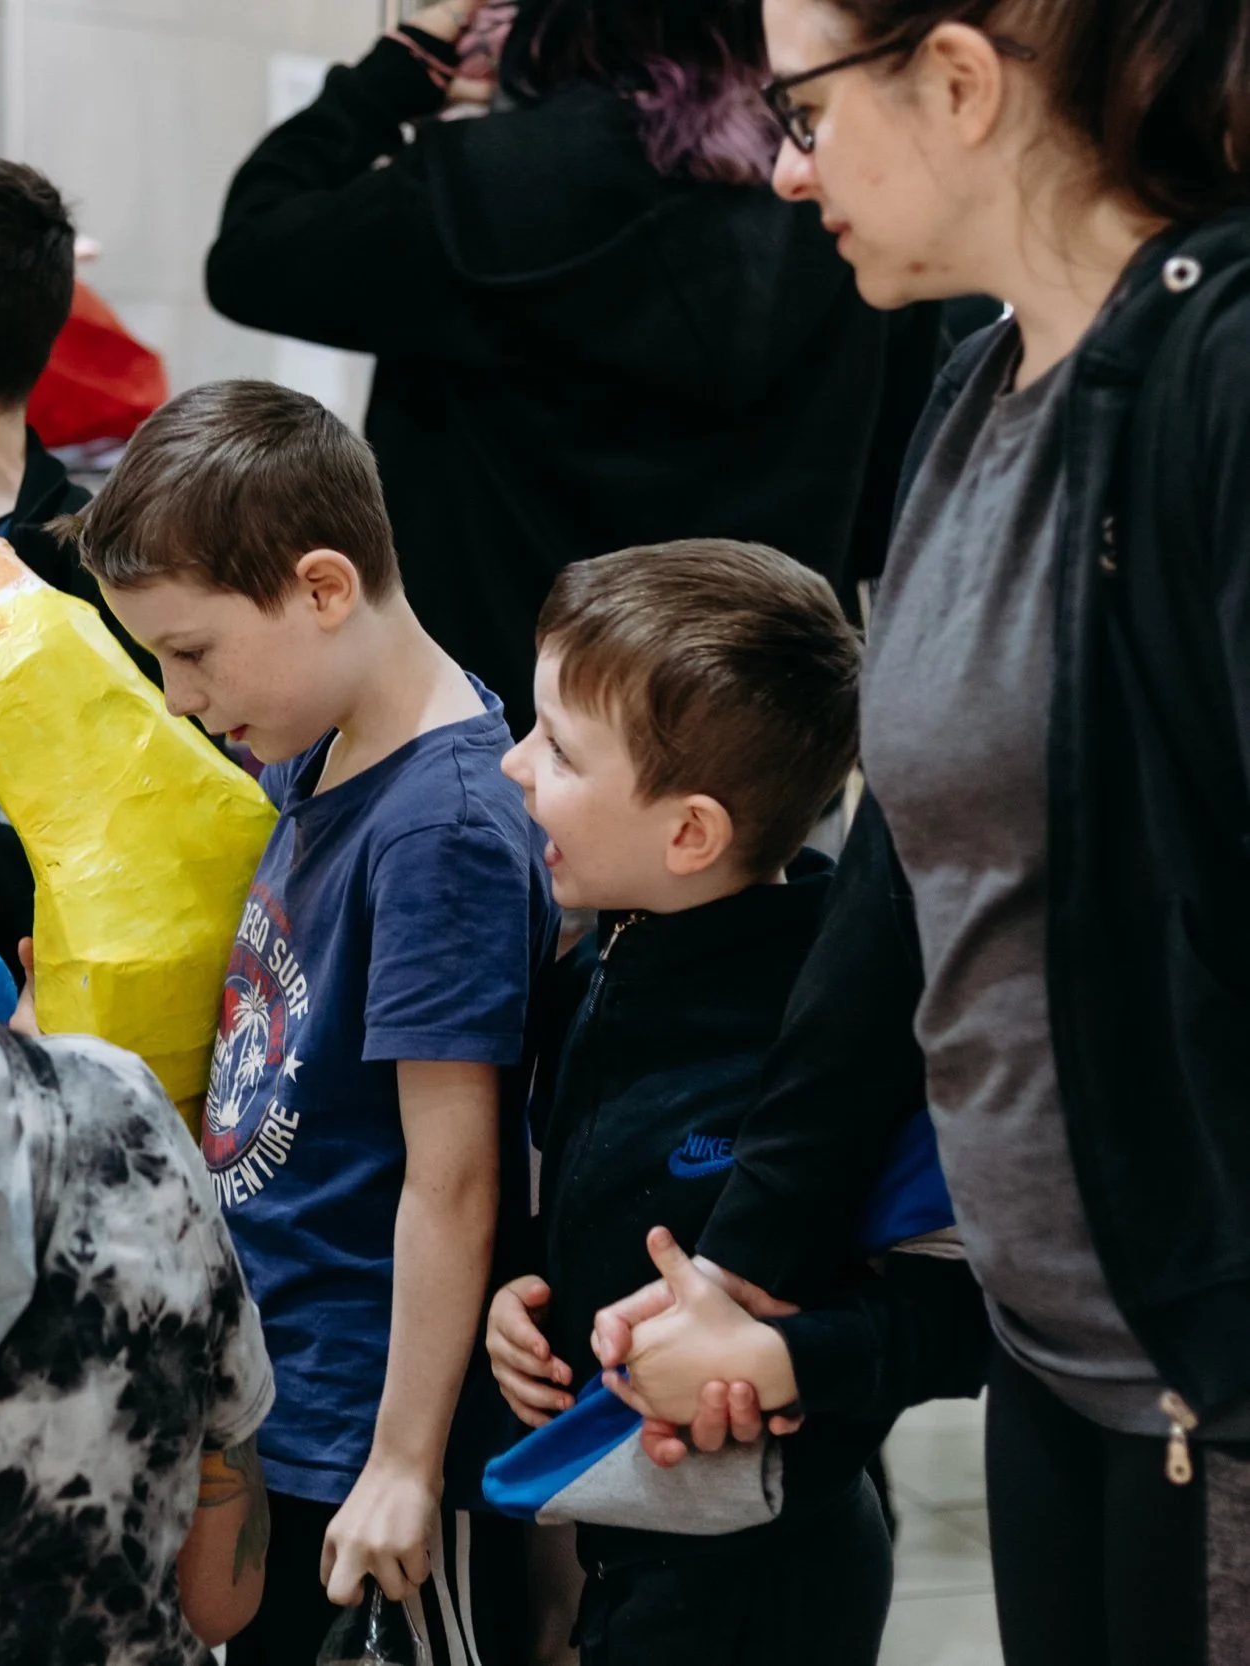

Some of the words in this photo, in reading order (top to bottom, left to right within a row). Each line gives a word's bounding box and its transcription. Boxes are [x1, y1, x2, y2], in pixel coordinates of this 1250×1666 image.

[268, 937, 309, 1021] SURF
[211, 1100, 300, 1209] DVENTURE
[682, 1131, 733, 1160] NIKE
